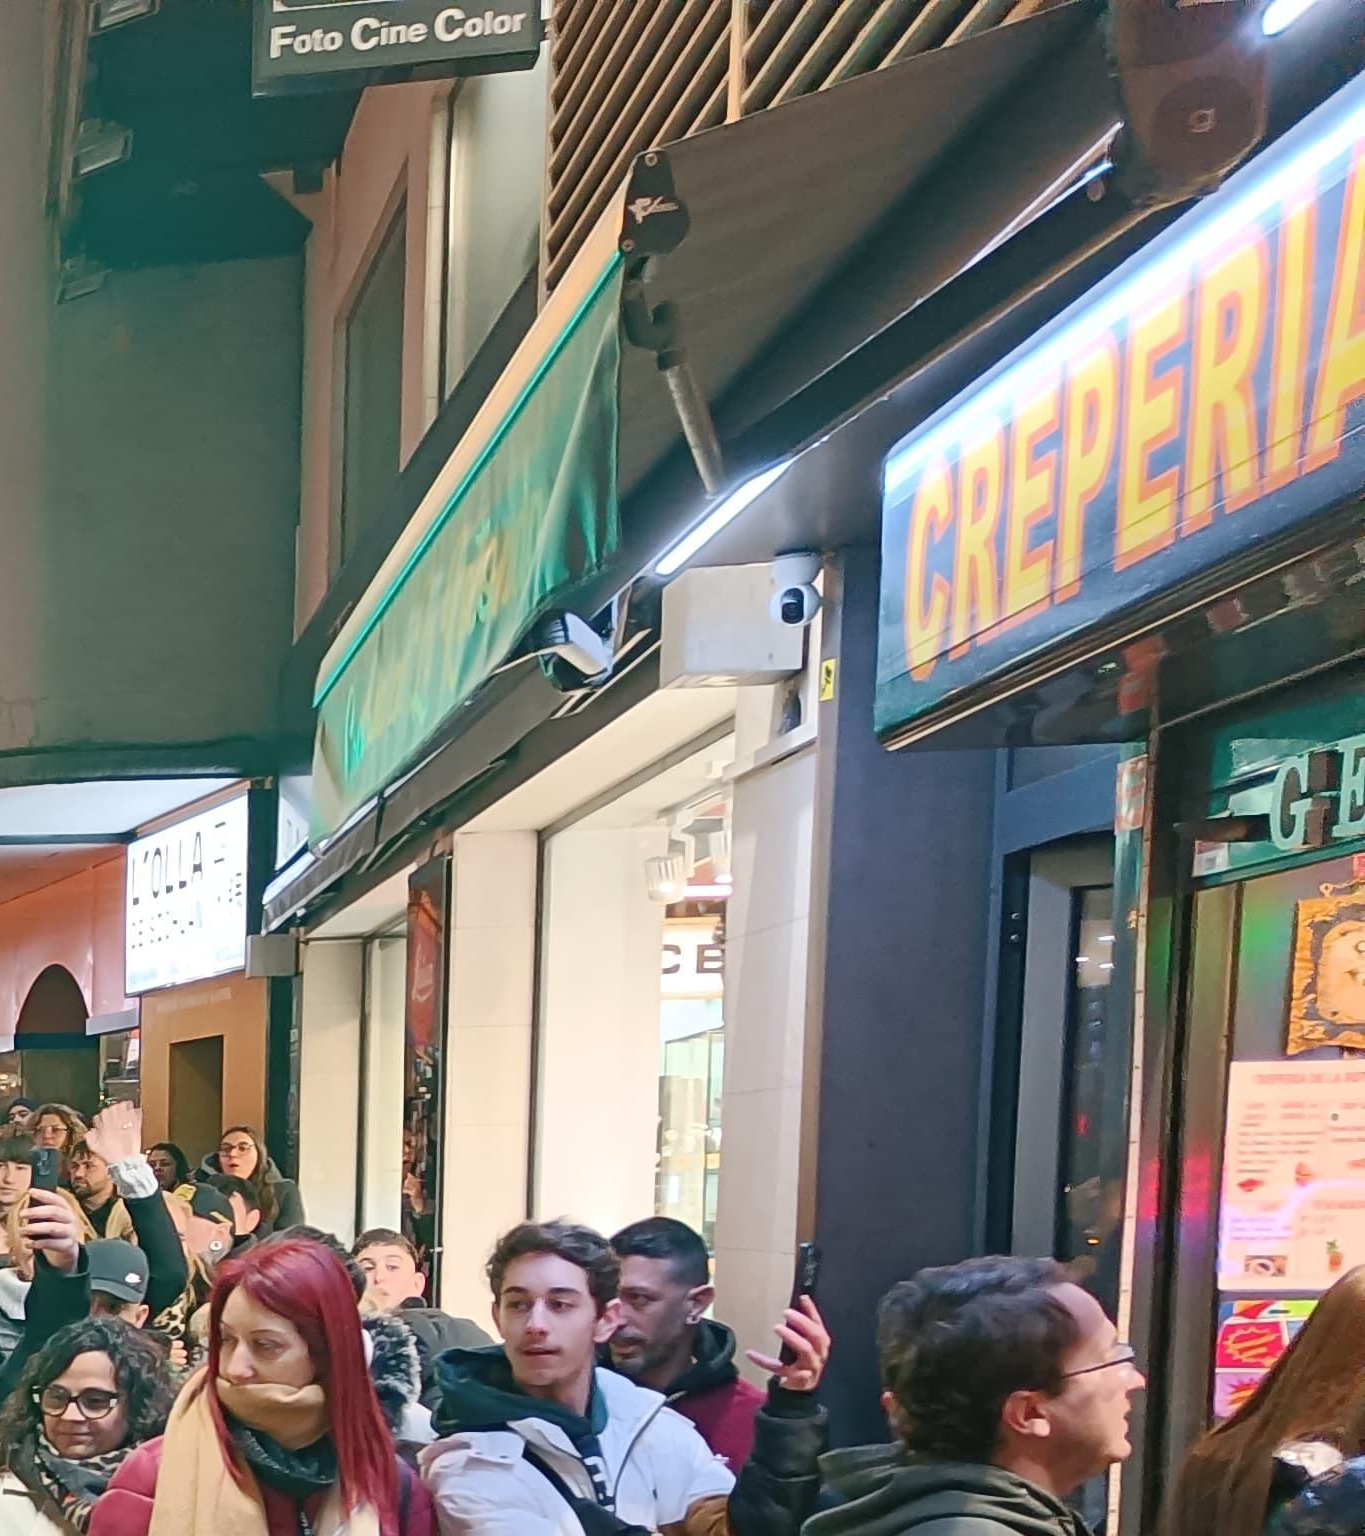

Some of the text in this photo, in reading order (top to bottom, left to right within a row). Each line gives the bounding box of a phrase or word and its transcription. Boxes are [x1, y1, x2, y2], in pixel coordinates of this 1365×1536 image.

[270, 8, 527, 59] Foto Cine Color
